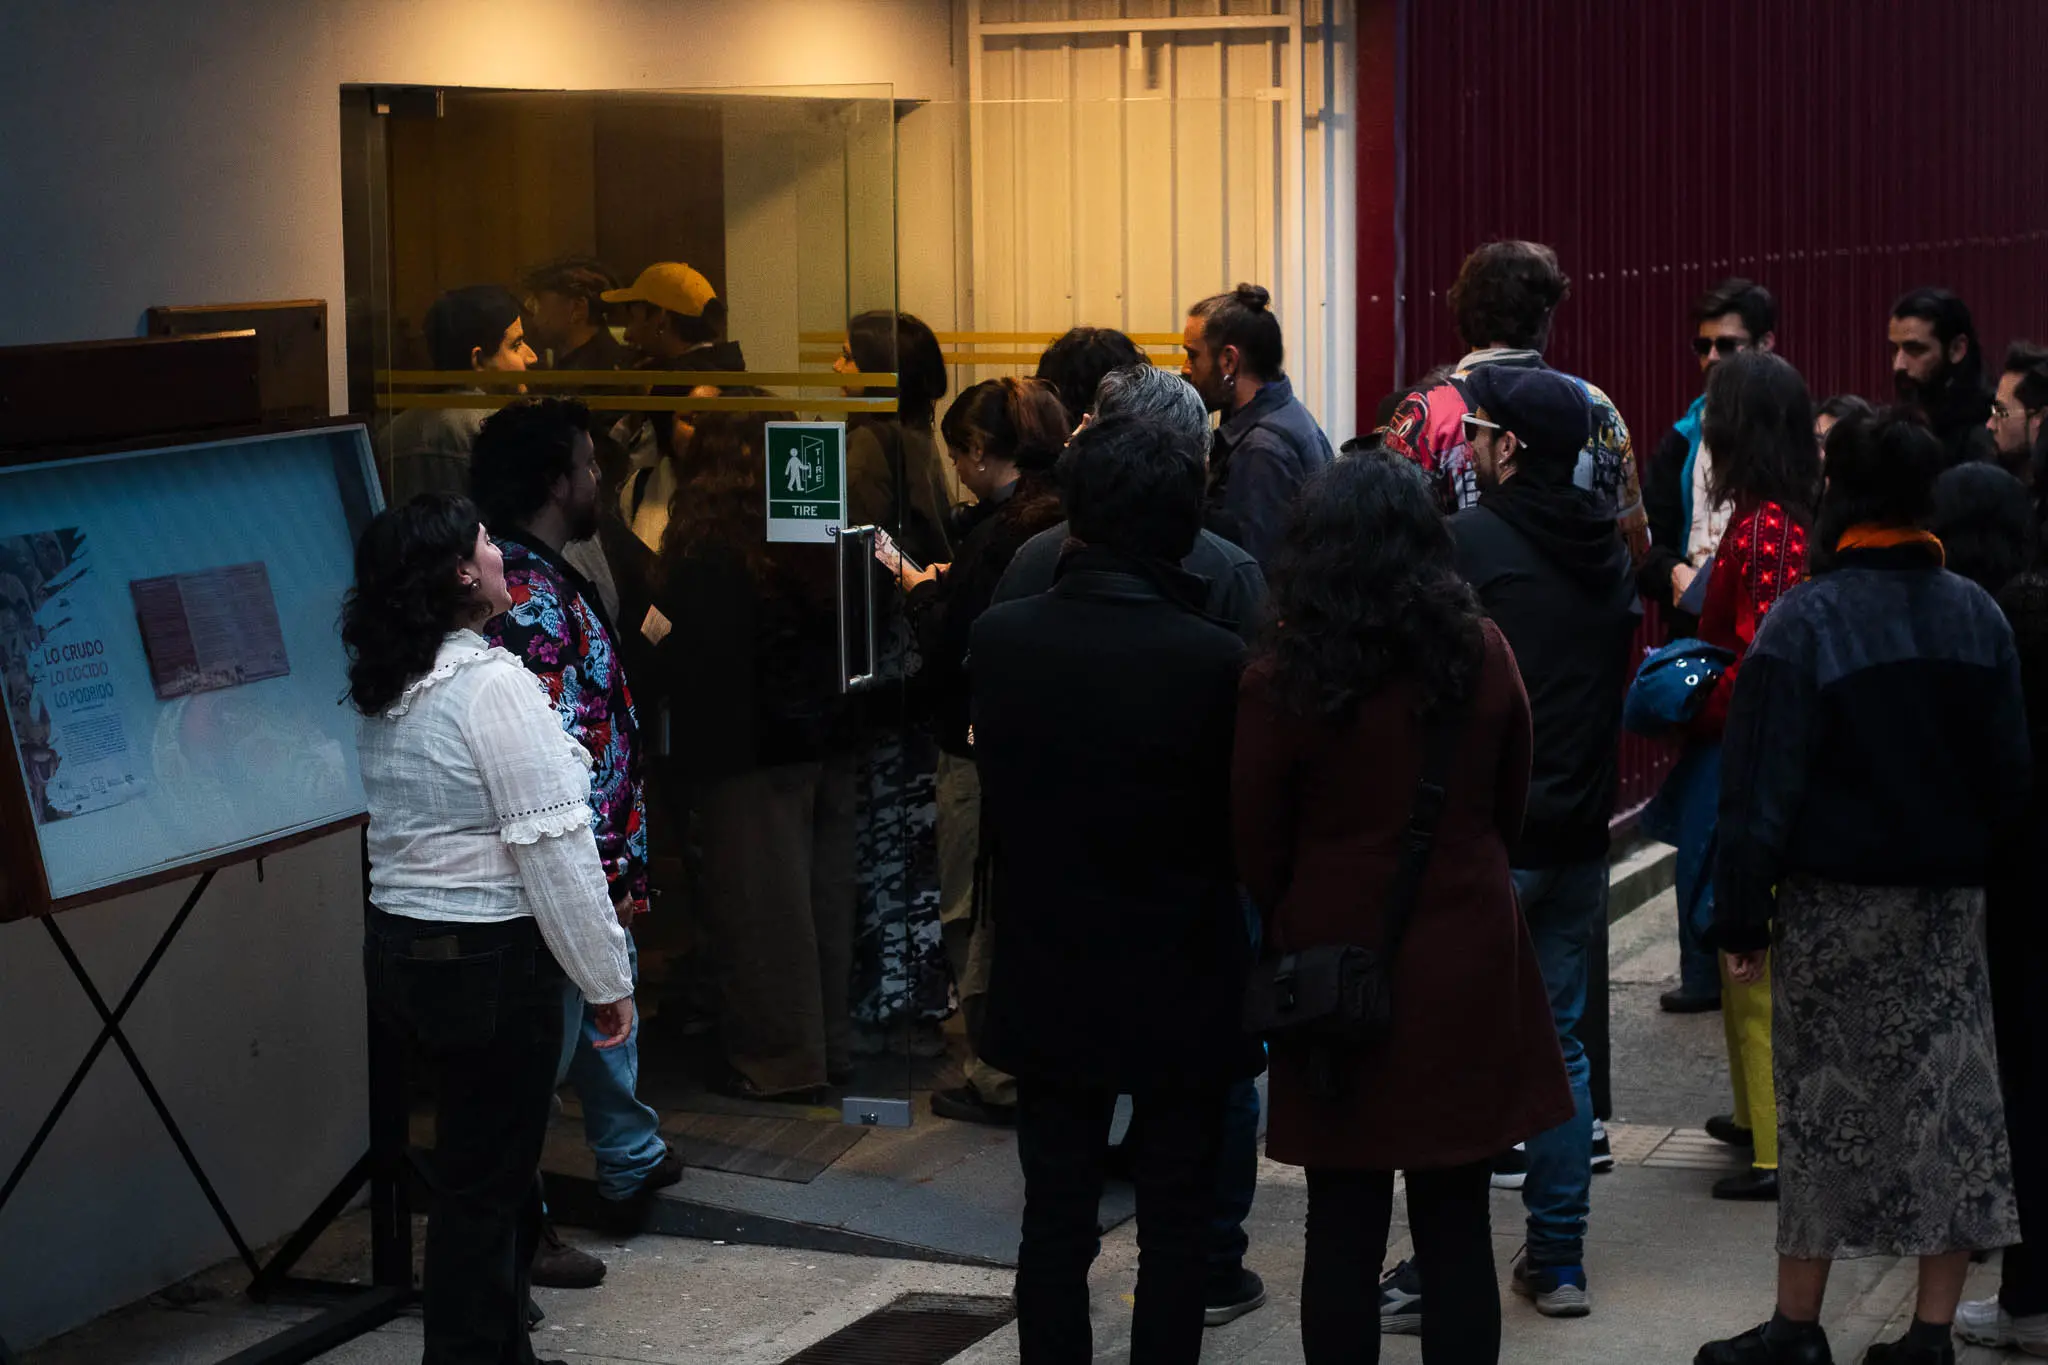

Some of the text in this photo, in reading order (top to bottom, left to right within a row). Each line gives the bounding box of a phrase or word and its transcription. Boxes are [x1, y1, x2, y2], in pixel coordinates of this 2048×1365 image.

[792, 505, 818, 516] TIRE
[43, 639, 104, 665] LO CRUDO
[50, 661, 109, 687] LO COCIDO
[54, 690, 68, 709] LO
[68, 682, 114, 706] PODRIDO
